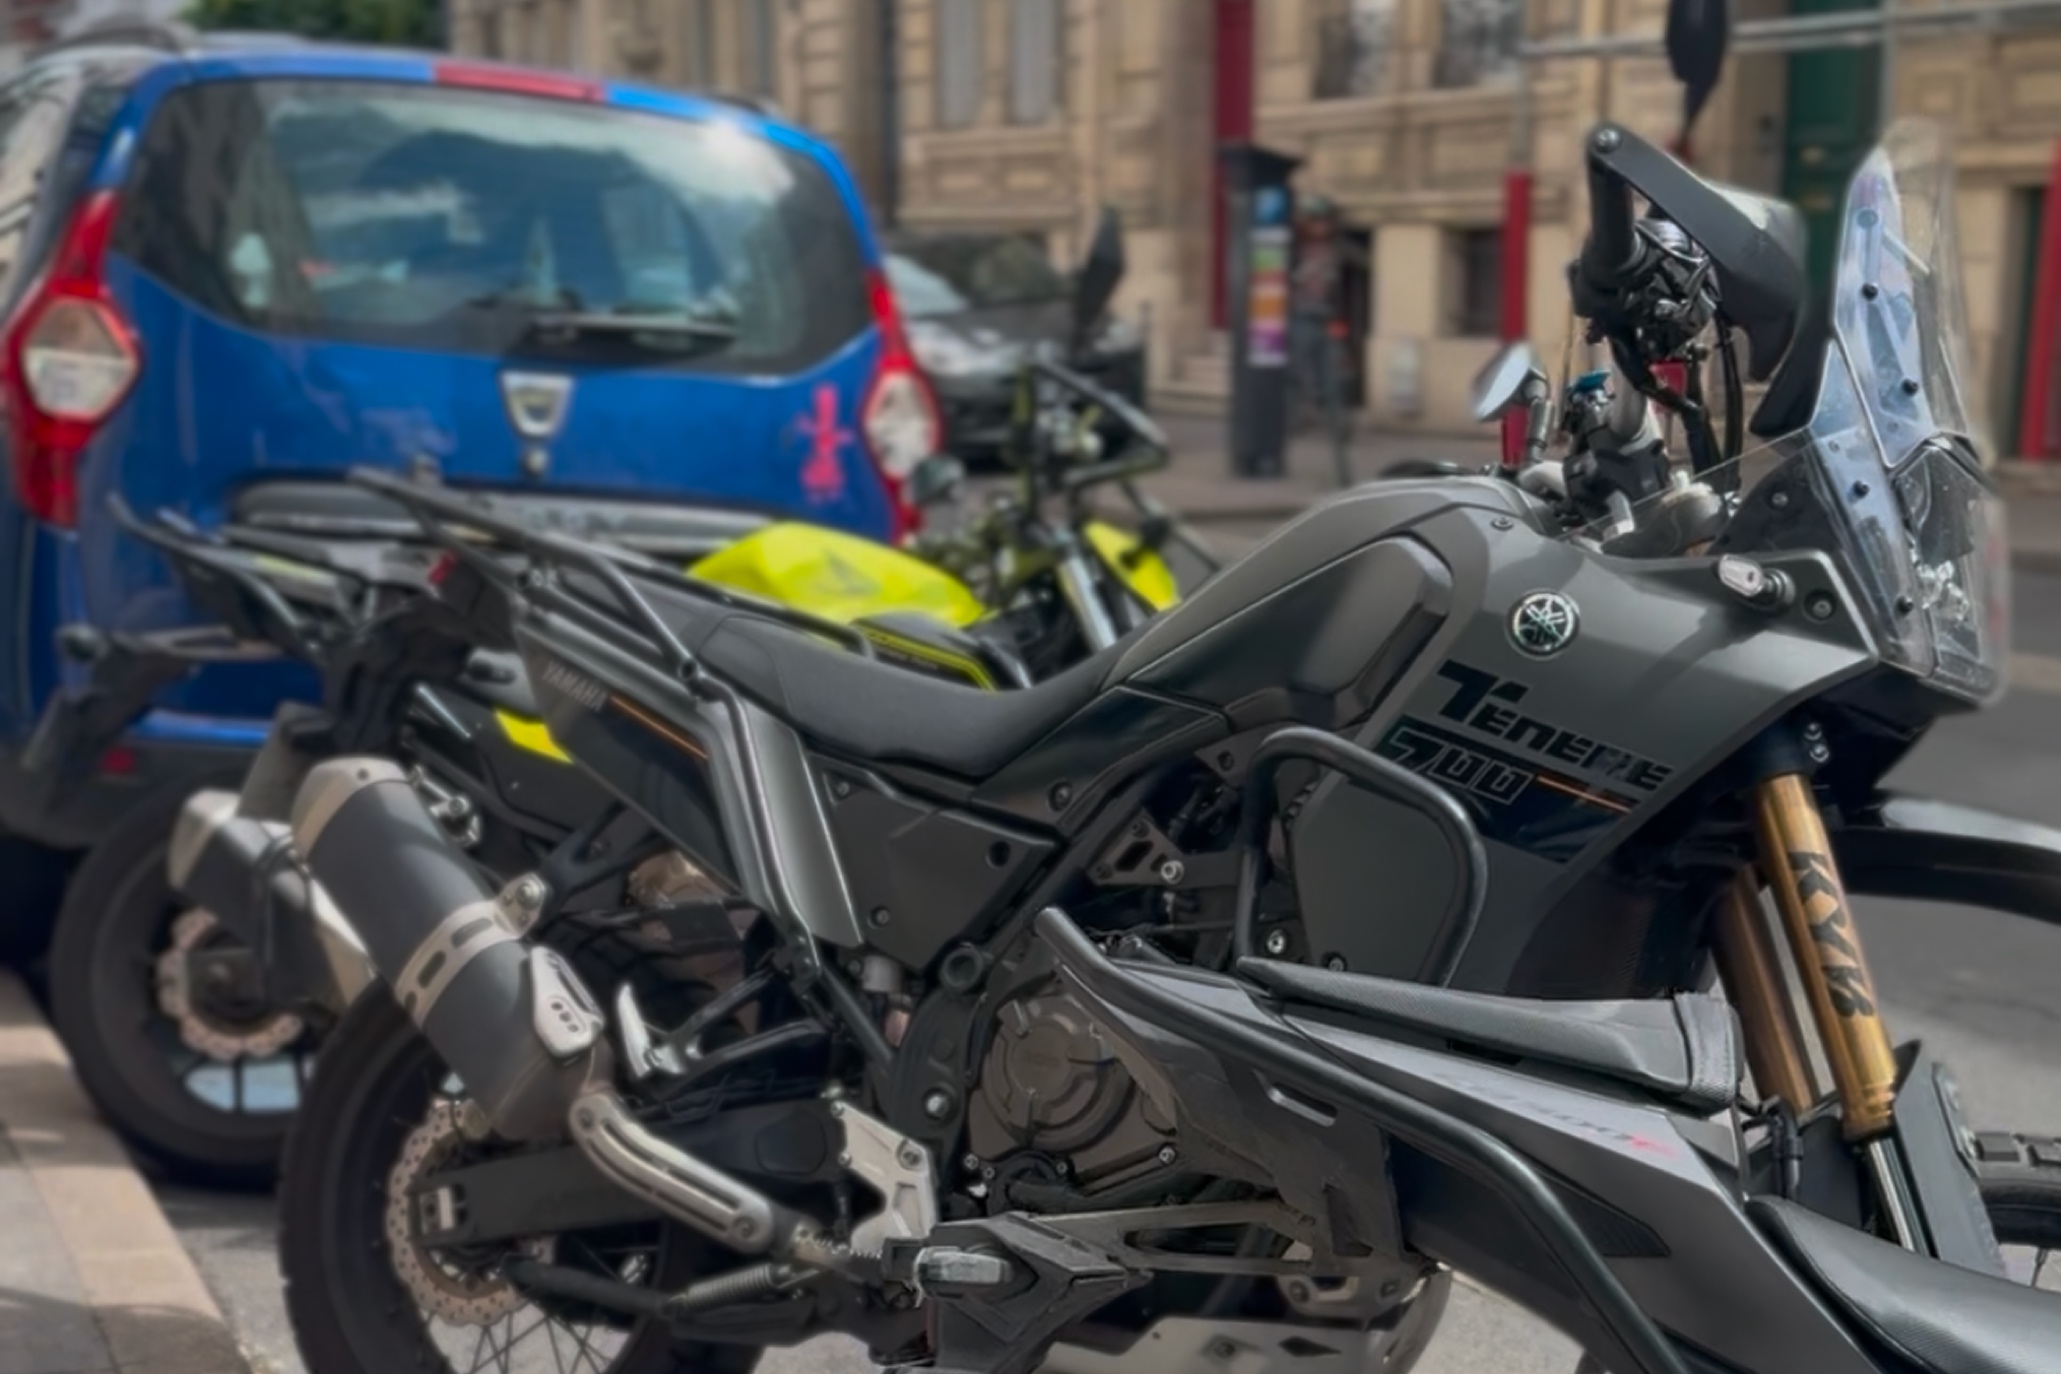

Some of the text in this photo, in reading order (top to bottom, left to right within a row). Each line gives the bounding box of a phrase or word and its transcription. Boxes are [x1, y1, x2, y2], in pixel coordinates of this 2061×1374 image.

[542, 661, 608, 712] YAMAHA
[1389, 726, 1534, 805] 700
[1788, 851, 1874, 1017] KYB
